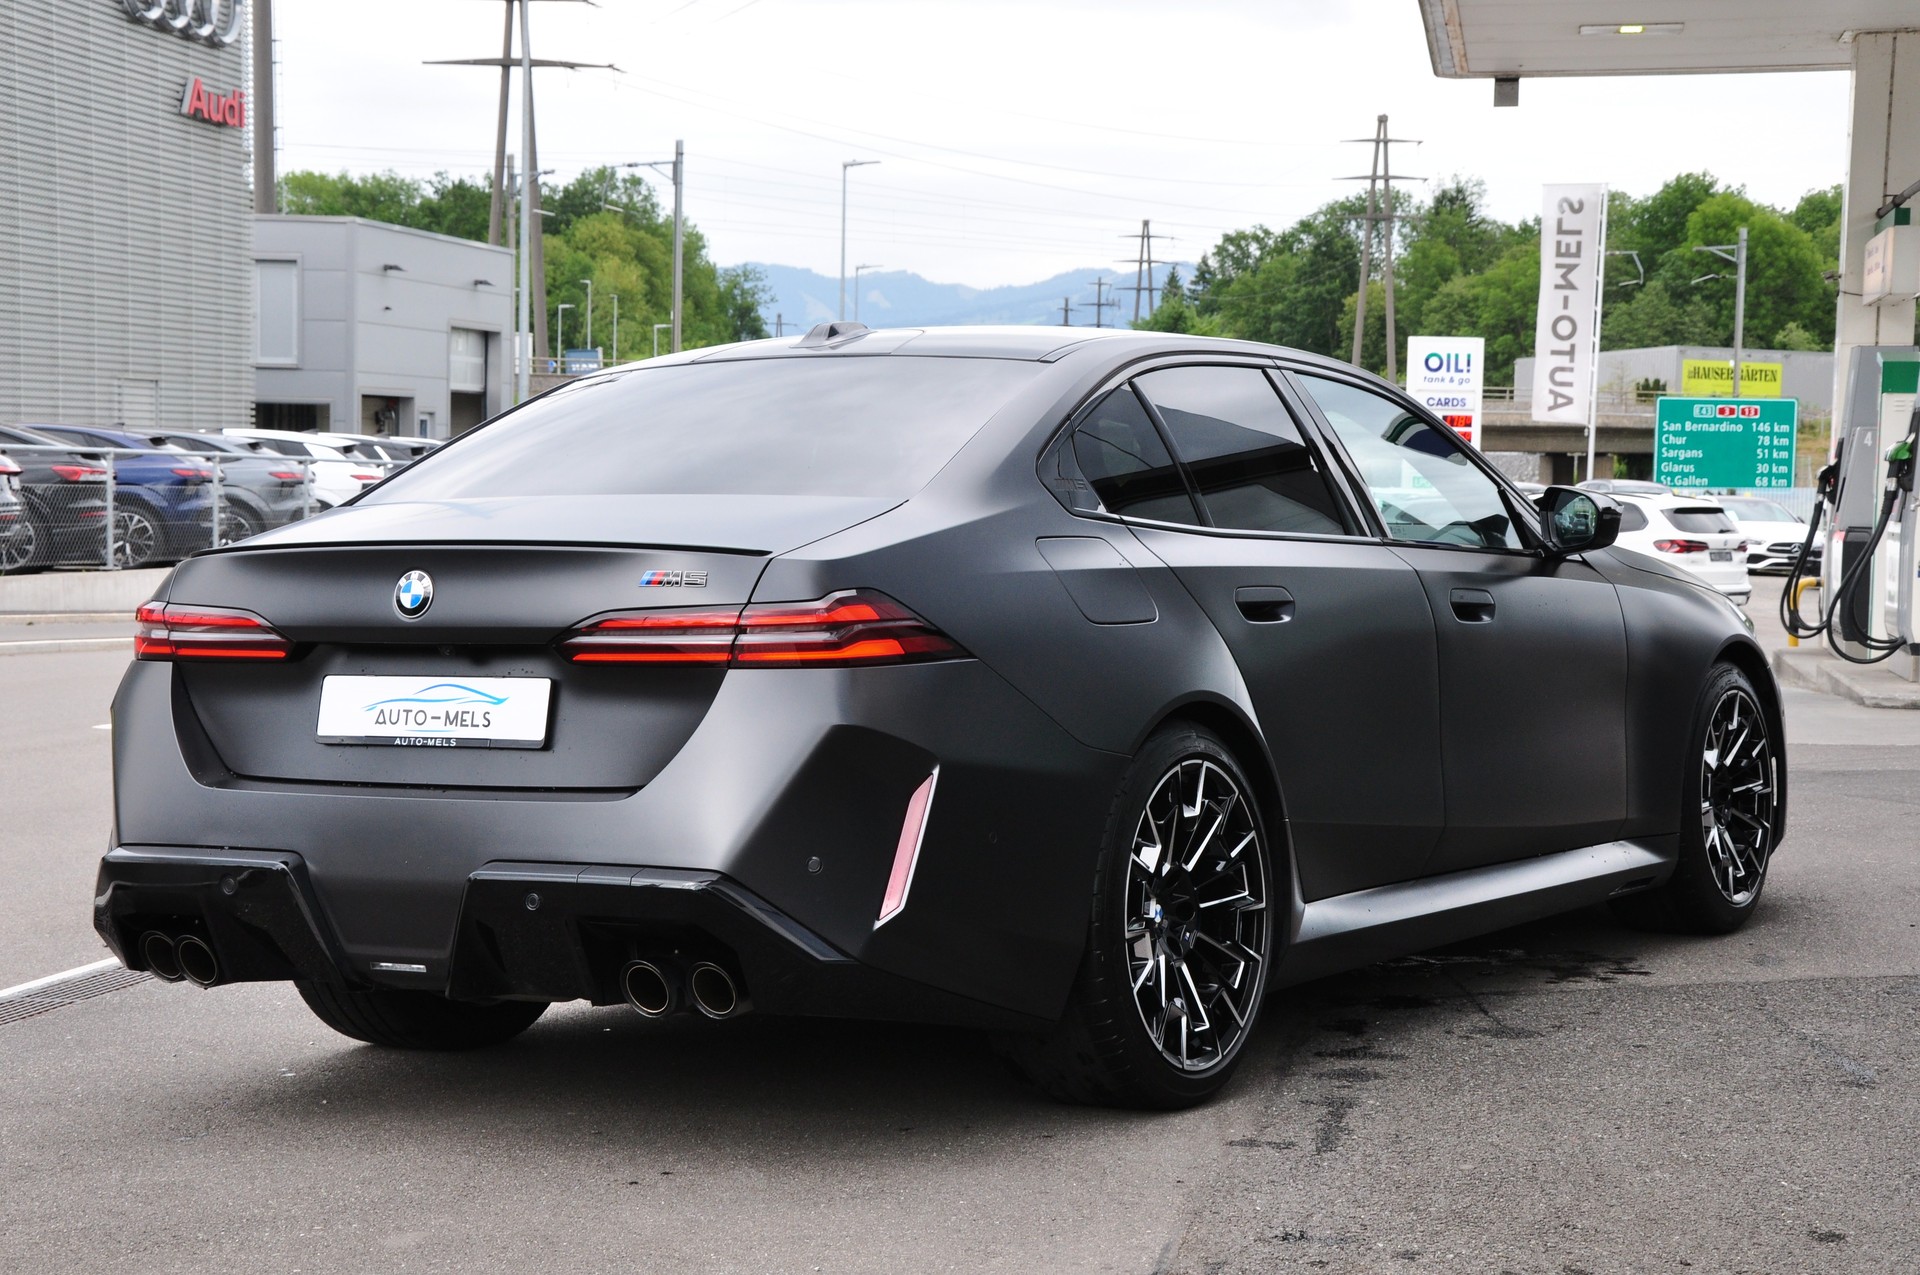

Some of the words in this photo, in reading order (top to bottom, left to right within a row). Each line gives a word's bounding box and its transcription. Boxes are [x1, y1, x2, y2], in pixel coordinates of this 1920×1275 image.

[188, 76, 246, 128] Audi
[1424, 352, 1471, 373] OIL!
[1458, 377, 1471, 385] go
[1426, 397, 1467, 407] CARDS
[1723, 406, 1730, 416] 3
[1744, 407, 1755, 416] 13
[1662, 421, 1682, 431] San
[1685, 421, 1743, 432] Bernardino
[1752, 422, 1771, 432] 146
[1773, 422, 1790, 433] km
[1661, 434, 1687, 444] Chur
[1757, 435, 1770, 445] 78
[1773, 436, 1789, 446] km
[1864, 431, 1873, 447] 4
[1661, 447, 1703, 460] Sargans
[1756, 448, 1769, 459] 51
[1772, 449, 1789, 459] km
[1661, 462, 1695, 472] Glarus
[1756, 463, 1769, 473] 30
[1772, 463, 1788, 473] km
[1660, 475, 1708, 486] St.Gallen
[1755, 477, 1768, 487] 68
[1771, 477, 1788, 487] km
[654, 570, 708, 588] M5
[374, 709, 491, 728] AUTO-MELS
[394, 738, 457, 747] AUTO-MELS
